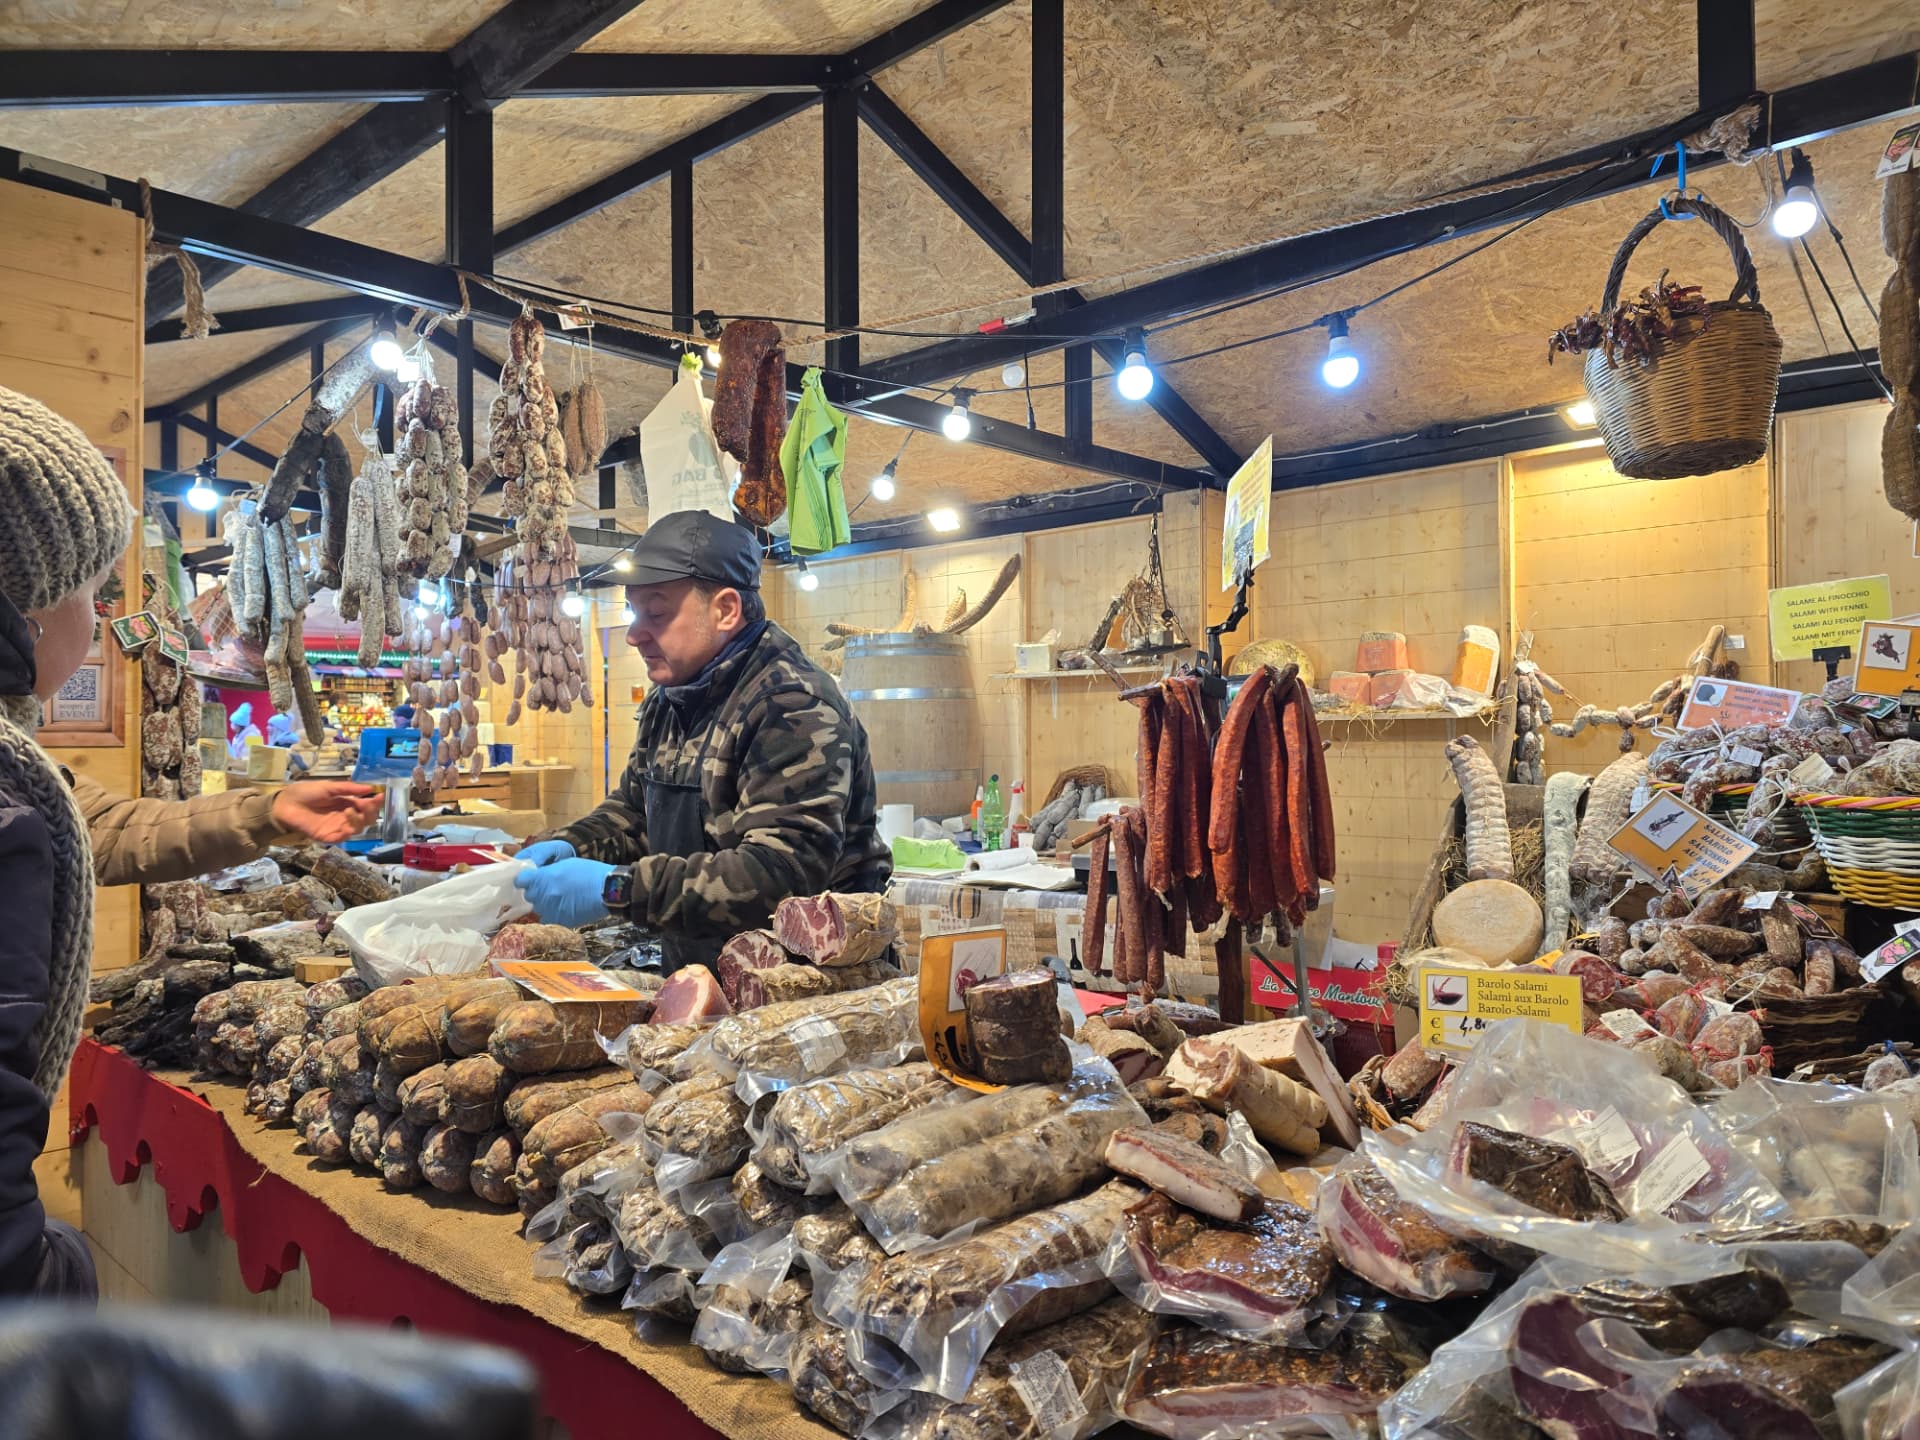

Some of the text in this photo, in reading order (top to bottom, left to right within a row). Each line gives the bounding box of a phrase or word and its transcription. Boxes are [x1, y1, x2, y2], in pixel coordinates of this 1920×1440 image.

[1817, 596, 1827, 604] AL
[1828, 590, 1870, 602] FINOCCHIO
[1789, 602, 1870, 619] SALAMI WITH FENNEL
[1792, 621, 1820, 631] SALAMI
[1822, 619, 1833, 627] AU
[1791, 633, 1820, 642] SALAMI
[1821, 630, 1836, 639] MIT
[59, 710, 95, 718] EVENTI
[1704, 823, 1735, 846] SALAMI
[1701, 835, 1734, 856] BAROLO
[1683, 848, 1697, 859] AU
[1259, 975, 1279, 992] La
[1477, 978, 1548, 991] Barolo Salami
[1477, 991, 1569, 1006] Salami aux Barolo
[1478, 1003, 1551, 1018] Barolo-Salami
[1460, 1015, 1487, 1037] 4,8
